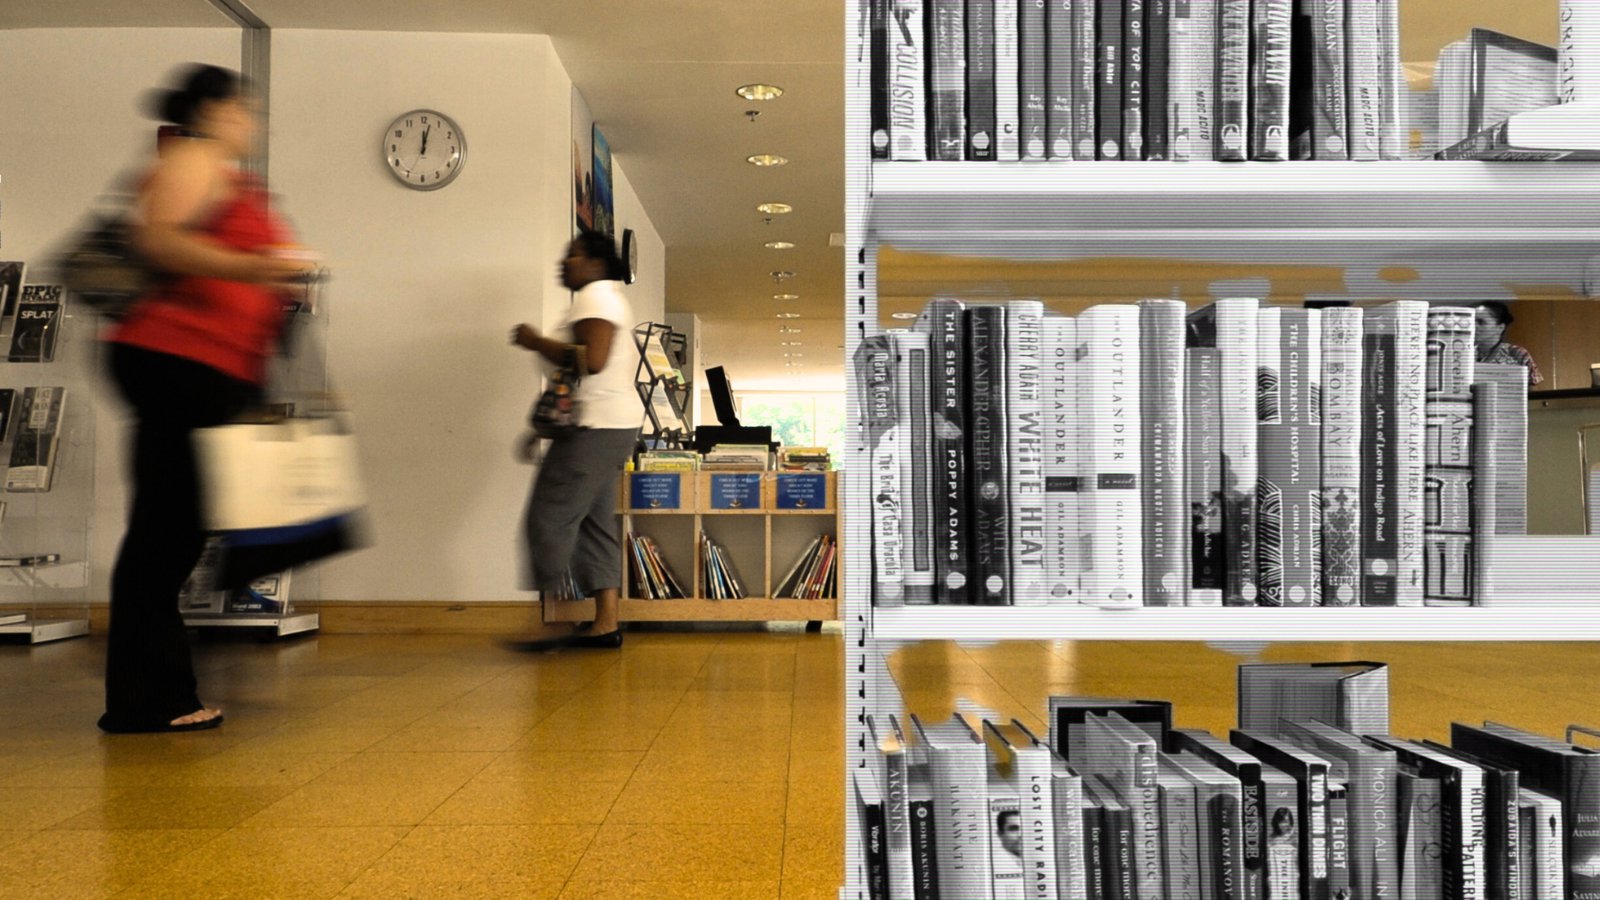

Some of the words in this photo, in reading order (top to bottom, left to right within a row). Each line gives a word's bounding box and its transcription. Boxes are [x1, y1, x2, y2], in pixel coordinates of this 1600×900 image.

[1131, 20, 1141, 36] OF
[1323, 18, 1337, 51] JUAN
[892, 42, 918, 130] COLLISION
[1131, 81, 1141, 113] CITY
[1196, 91, 1207, 114] MARC
[1360, 87, 1371, 111] MARC
[1199, 115, 1210, 140] ACITO
[1363, 112, 1375, 137] ACITO
[20, 310, 54, 319] SPLAT
[945, 311, 955, 343] THE
[1018, 314, 1039, 359] CHERRY
[1289, 323, 1298, 347] THE
[946, 350, 956, 409] SISTER
[973, 315, 990, 412] ALEXANDER
[1200, 354, 1212, 377] Half
[1410, 364, 1420, 385] NO
[1451, 338, 1466, 395] Cecelia
[1019, 364, 1039, 400] ADAIR
[1289, 351, 1299, 423] CHILDREN'S
[1377, 374, 1385, 395] AGEE
[876, 385, 890, 418] Acosta
[1055, 347, 1067, 465] OUTLANDER
[1112, 337, 1125, 461] OUTLANDER
[1200, 398, 1212, 432] Yellow
[1326, 362, 1345, 447] BOMBAY
[1409, 388, 1421, 429] PLACE
[1375, 404, 1386, 429] Acts
[1018, 411, 1042, 494] WHITE
[1153, 422, 1163, 484] CHIMAMANDA
[1202, 435, 1212, 454] Sun
[1376, 431, 1387, 442] of
[1408, 433, 1420, 463] LIKE
[1450, 413, 1465, 463] Ahern
[1290, 426, 1300, 485] HOSPITAL
[1375, 444, 1385, 467] Love
[948, 449, 958, 500] POPPY
[1376, 468, 1384, 482] on
[1408, 466, 1420, 502] HERE
[1154, 489, 1163, 517] NGOZI
[1373, 484, 1385, 515] Indigo
[882, 515, 897, 536] Casa
[993, 515, 1006, 552] WILL
[1292, 504, 1300, 531] CHRIS
[1376, 517, 1386, 542] Road
[949, 507, 959, 562] ADAMS
[978, 509, 992, 565] ADAMS
[1020, 507, 1044, 569] HEAT
[1154, 521, 1164, 559] ADICHIE
[1293, 533, 1301, 569] ADRIAN
[1402, 508, 1416, 562] AHERN
[884, 541, 900, 576] Dracula
[1058, 525, 1066, 578] ADAMSON
[1116, 525, 1124, 580] ADAMSON
[1241, 540, 1251, 586] ADLER
[889, 769, 903, 834] AKUNIN
[1031, 775, 1042, 811] LOST
[1066, 789, 1076, 816] war
[1312, 773, 1325, 803] TWO
[1372, 767, 1386, 831] MONICA
[949, 785, 965, 870] HAKAWATI
[967, 811, 978, 844] THE
[1064, 820, 1080, 837] by
[1141, 755, 1160, 880] disobedience
[1243, 785, 1260, 860] EASTSIDE
[1312, 805, 1326, 835] THIN
[1471, 787, 1486, 847] HOLDING
[1507, 800, 1518, 858] ZUBAIDA'S
[870, 825, 880, 854] Vibrator
[919, 821, 928, 849] BORIS
[1034, 820, 1044, 851] CITY
[1091, 827, 1101, 841] for
[1119, 830, 1130, 844] for
[1332, 817, 1346, 869] FLIGHT
[1374, 837, 1387, 862] ALI
[1092, 845, 1100, 864] one
[1121, 848, 1129, 868] one
[1221, 828, 1234, 896] ROMANOV
[1312, 837, 1327, 879] DIMES
[921, 852, 931, 891] AKUNIN
[1094, 868, 1103, 896] more
[1122, 871, 1132, 900] more
[1376, 881, 1388, 897] IN
